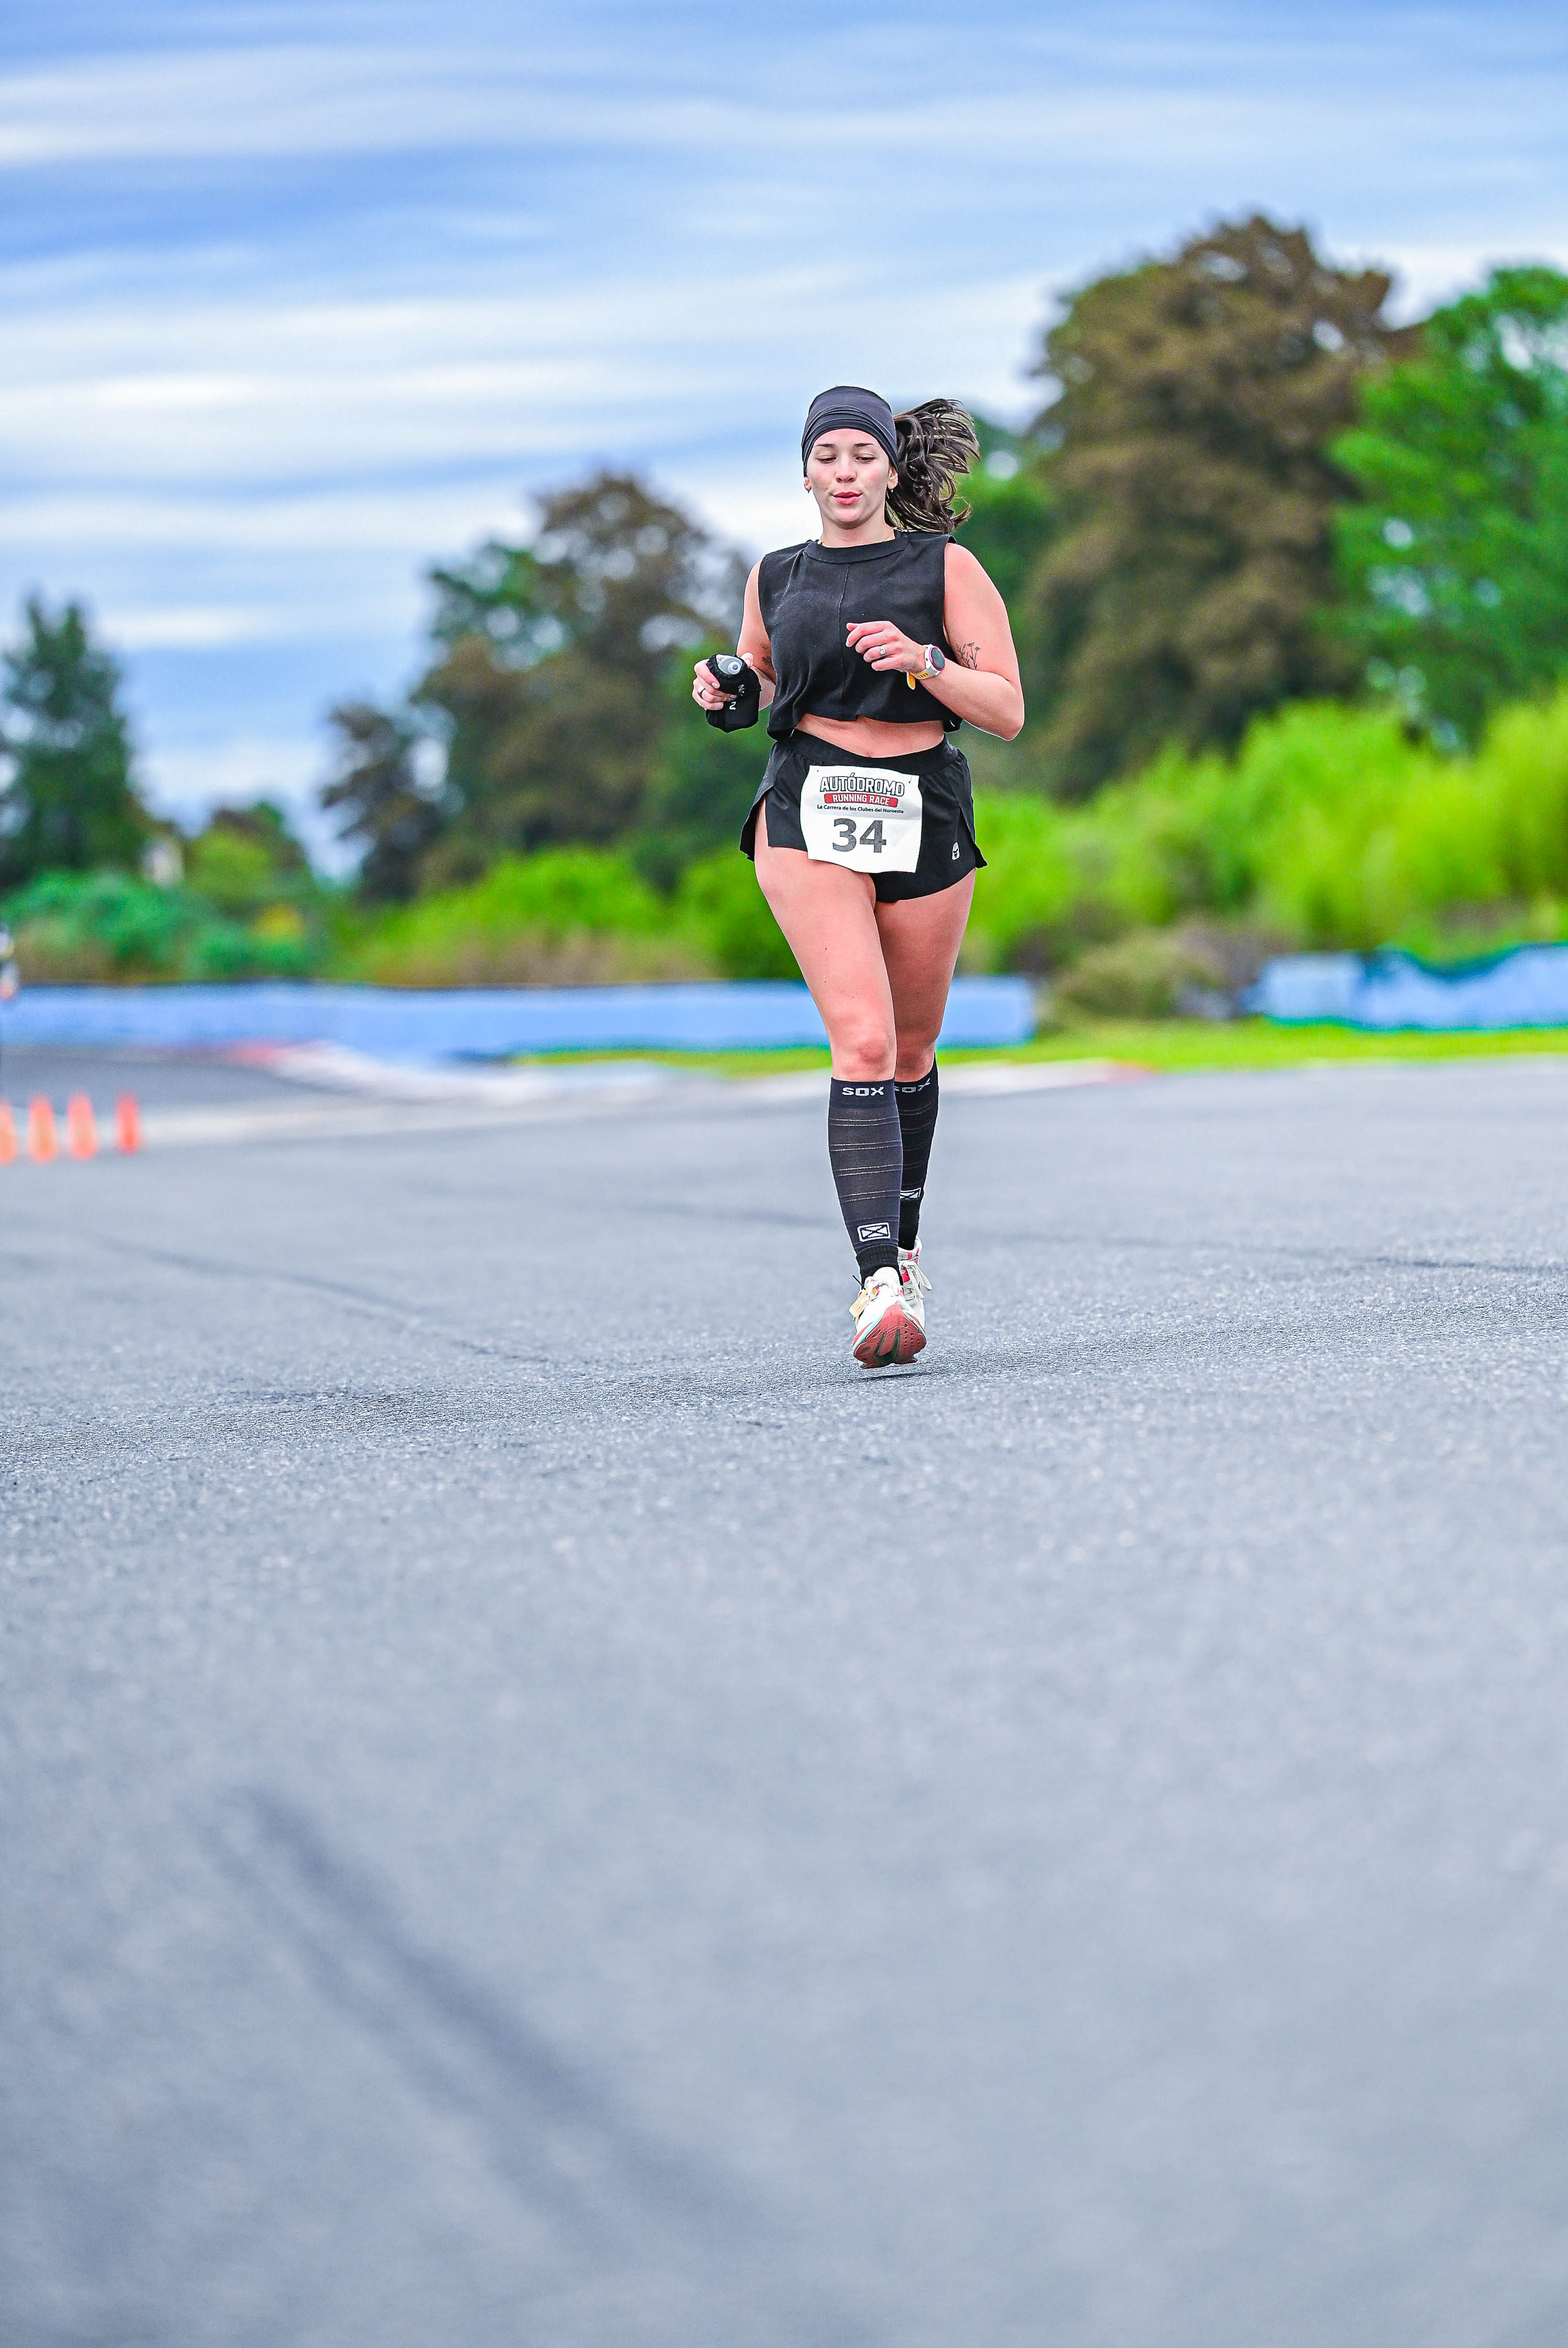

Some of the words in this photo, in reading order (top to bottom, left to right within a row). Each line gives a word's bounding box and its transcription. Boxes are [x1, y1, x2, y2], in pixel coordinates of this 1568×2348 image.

[820, 773, 905, 796] AUTÓDROMO
[832, 794, 867, 803] RUNNING
[869, 796, 890, 806] RACE
[832, 818, 886, 853] 34
[842, 1086, 884, 1096] SOX
